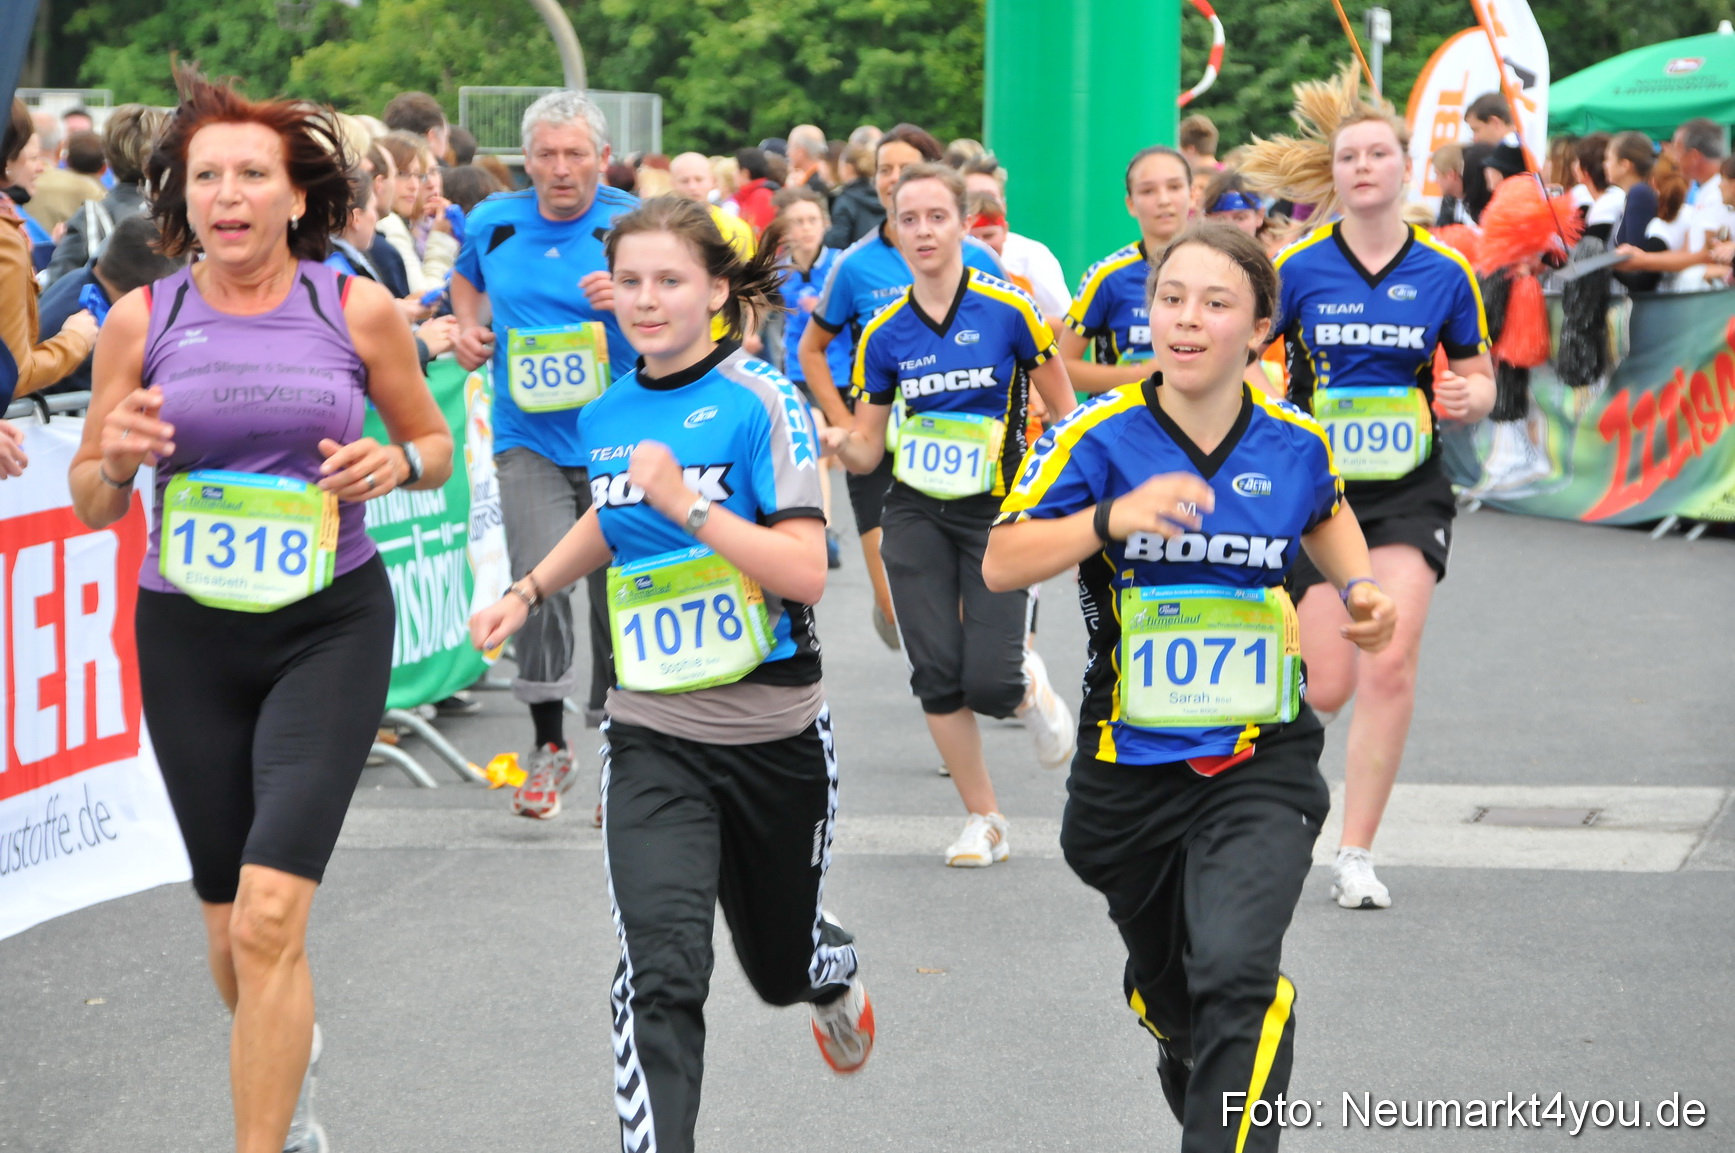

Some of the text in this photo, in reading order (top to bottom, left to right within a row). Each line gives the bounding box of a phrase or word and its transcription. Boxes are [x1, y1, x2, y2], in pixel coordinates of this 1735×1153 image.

[1317, 303, 1364, 314] TEAM
[1314, 323, 1426, 349] BOCK
[519, 352, 586, 390] 368
[898, 354, 937, 371] TEAM
[900, 366, 998, 400] BOCK
[1324, 421, 1414, 453] 1090
[902, 439, 982, 478] 1091
[590, 463, 735, 512] BOK
[173, 518, 309, 577] 1318
[1124, 531, 1289, 570] BOCK
[185, 571, 248, 588] Elisabeth
[624, 593, 743, 662] 1078
[0, 529, 128, 772] ER
[1133, 637, 1268, 688] 1071
[1169, 691, 1210, 705] Sarah
